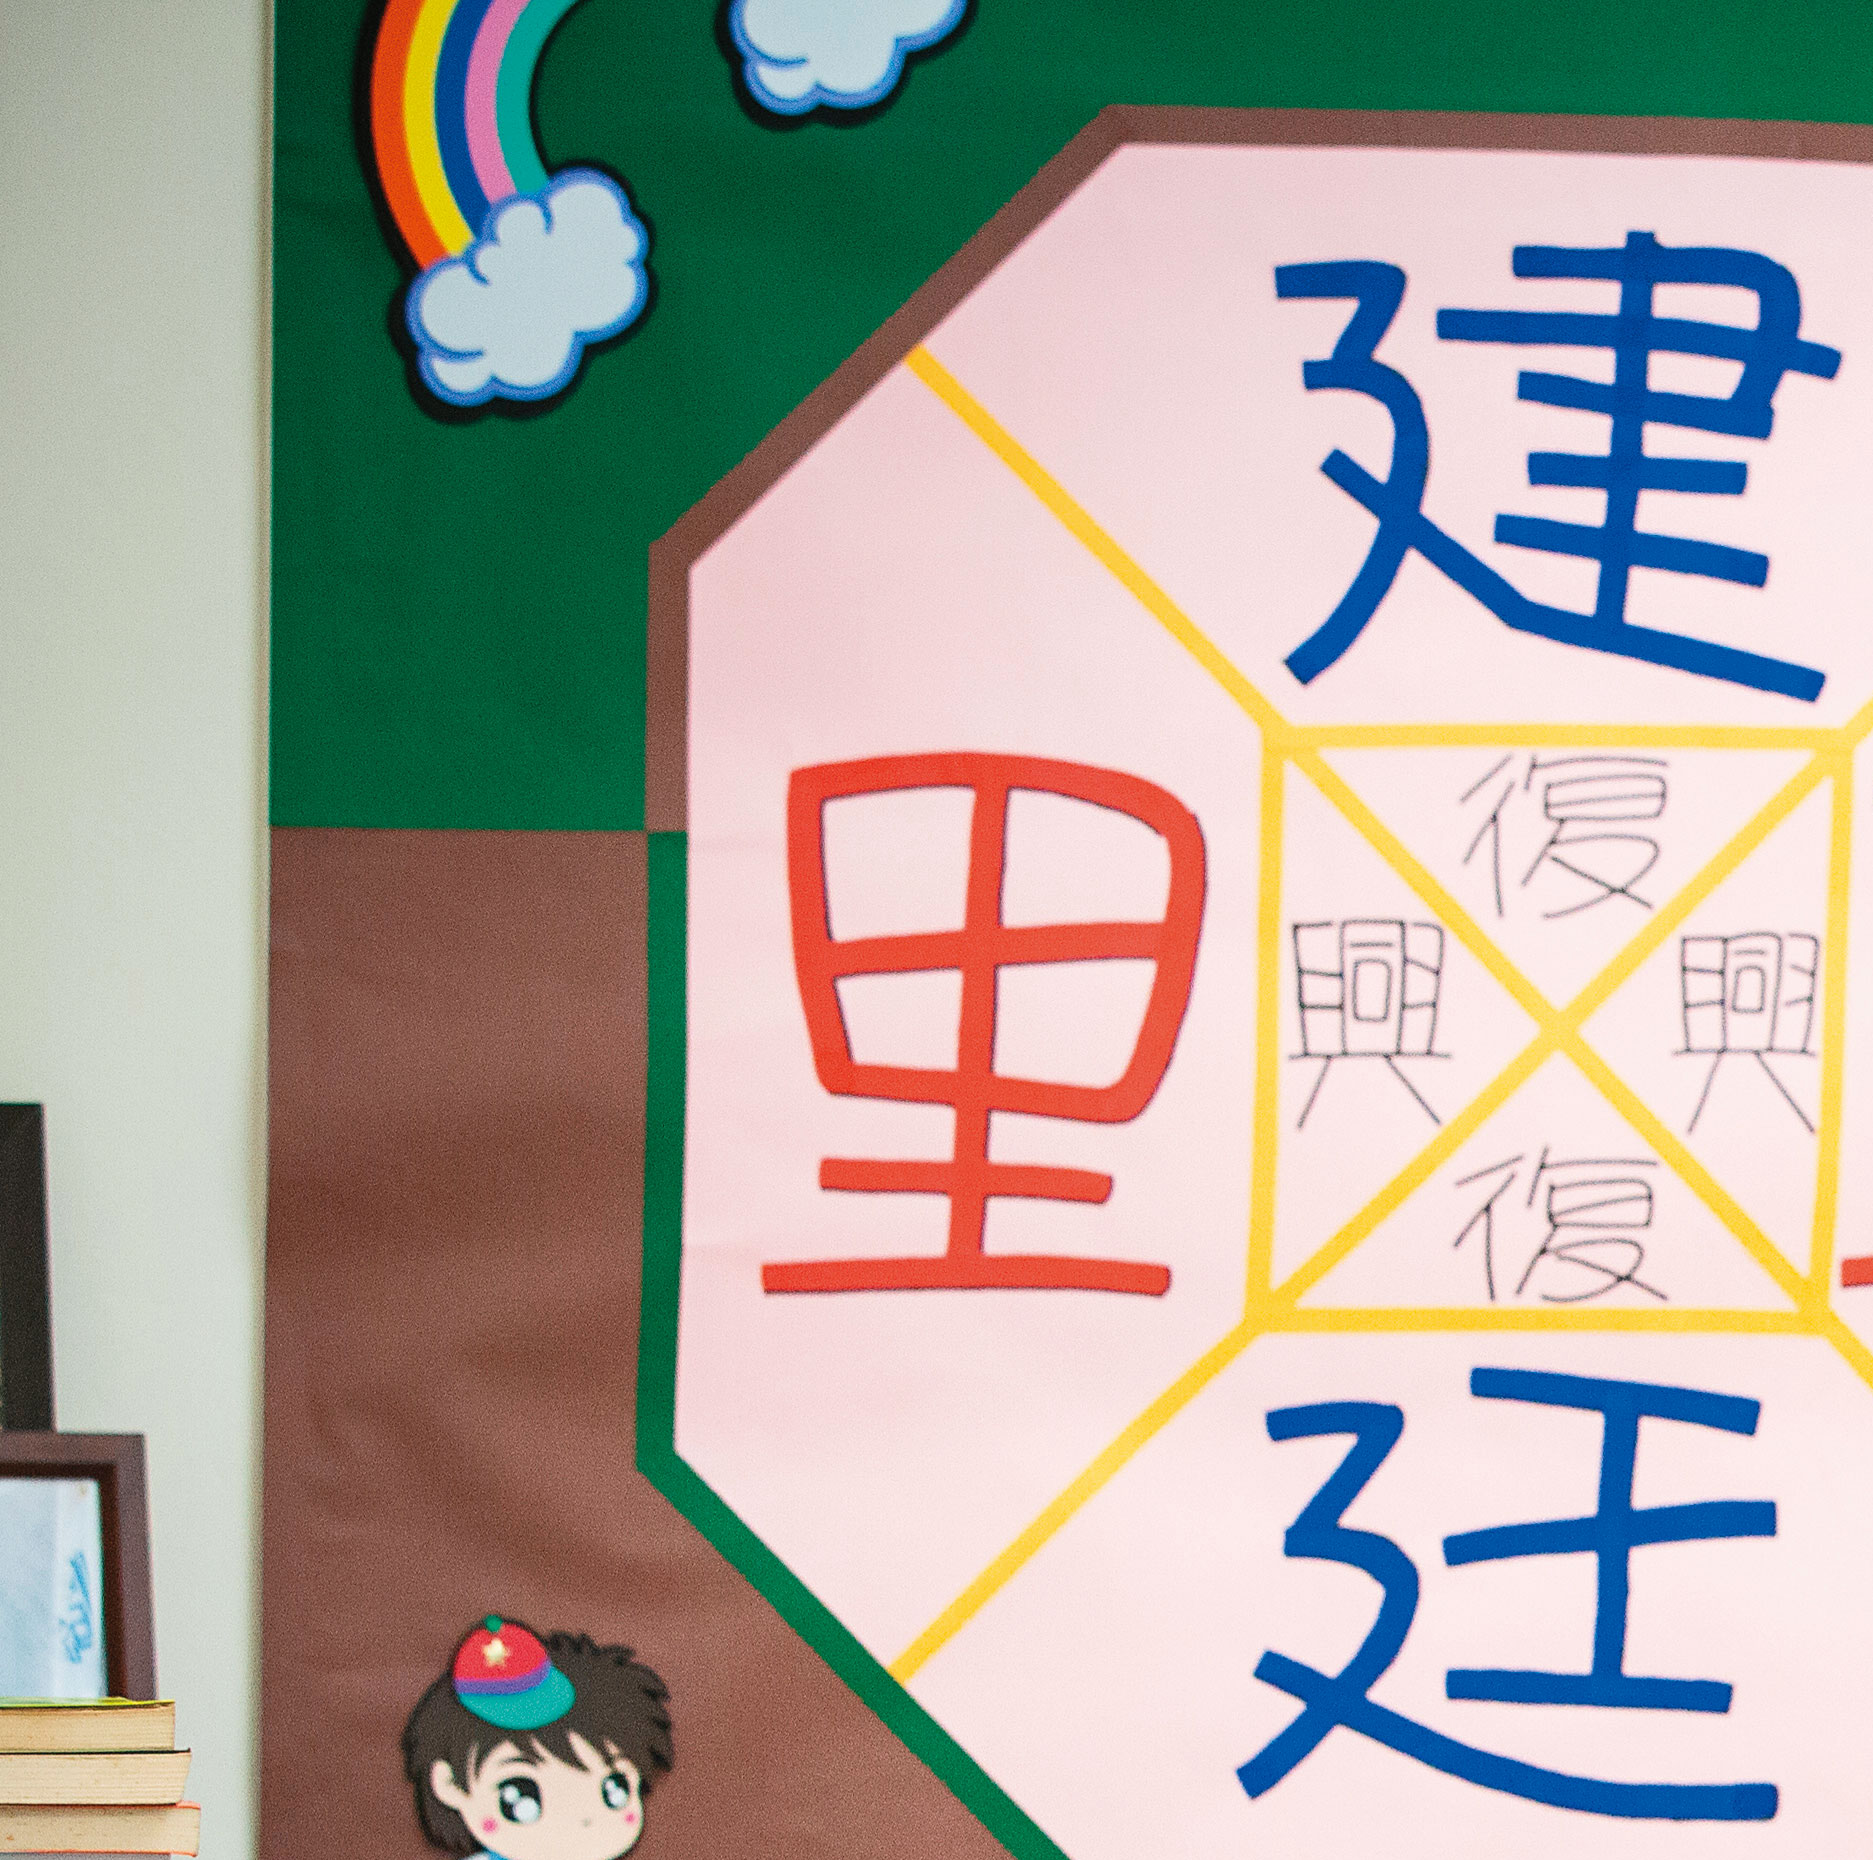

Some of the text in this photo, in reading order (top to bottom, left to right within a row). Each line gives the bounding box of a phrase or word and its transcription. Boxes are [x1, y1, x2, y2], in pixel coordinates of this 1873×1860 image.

[1272, 231, 1841, 701] 建
[1460, 752, 1670, 920] 復
[762, 749, 1210, 1296] 里
[1288, 917, 1453, 1130] 興
[1671, 930, 1820, 1135] 興
[1453, 1144, 1669, 1303] 復
[1235, 1366, 1780, 1823] 廷
